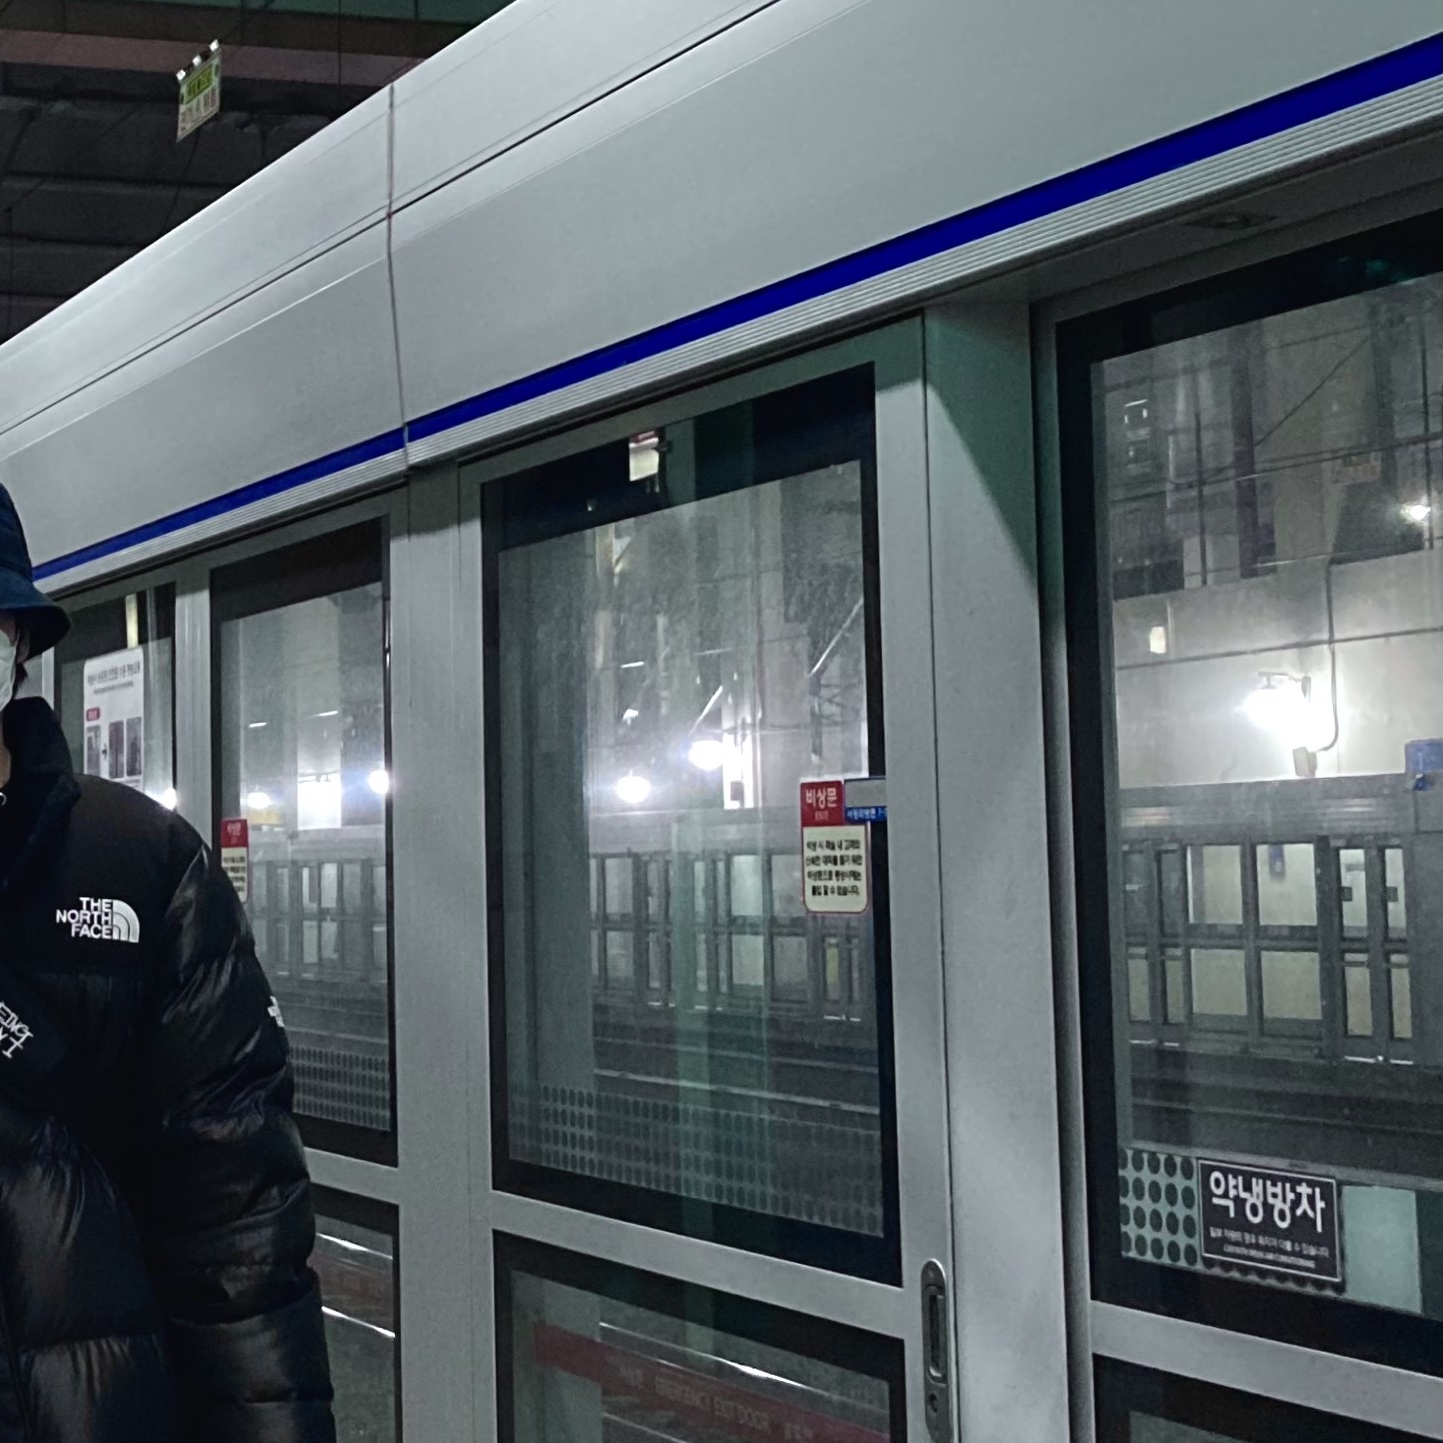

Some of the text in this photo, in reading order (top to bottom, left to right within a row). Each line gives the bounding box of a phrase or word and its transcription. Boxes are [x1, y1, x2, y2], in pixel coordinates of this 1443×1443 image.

[805, 787, 838, 809] 비상문
[79, 896, 113, 912] THE
[55, 908, 113, 926] NORTH
[70, 922, 113, 939] FACE
[1208, 1171, 1326, 1233] 약냉방차
